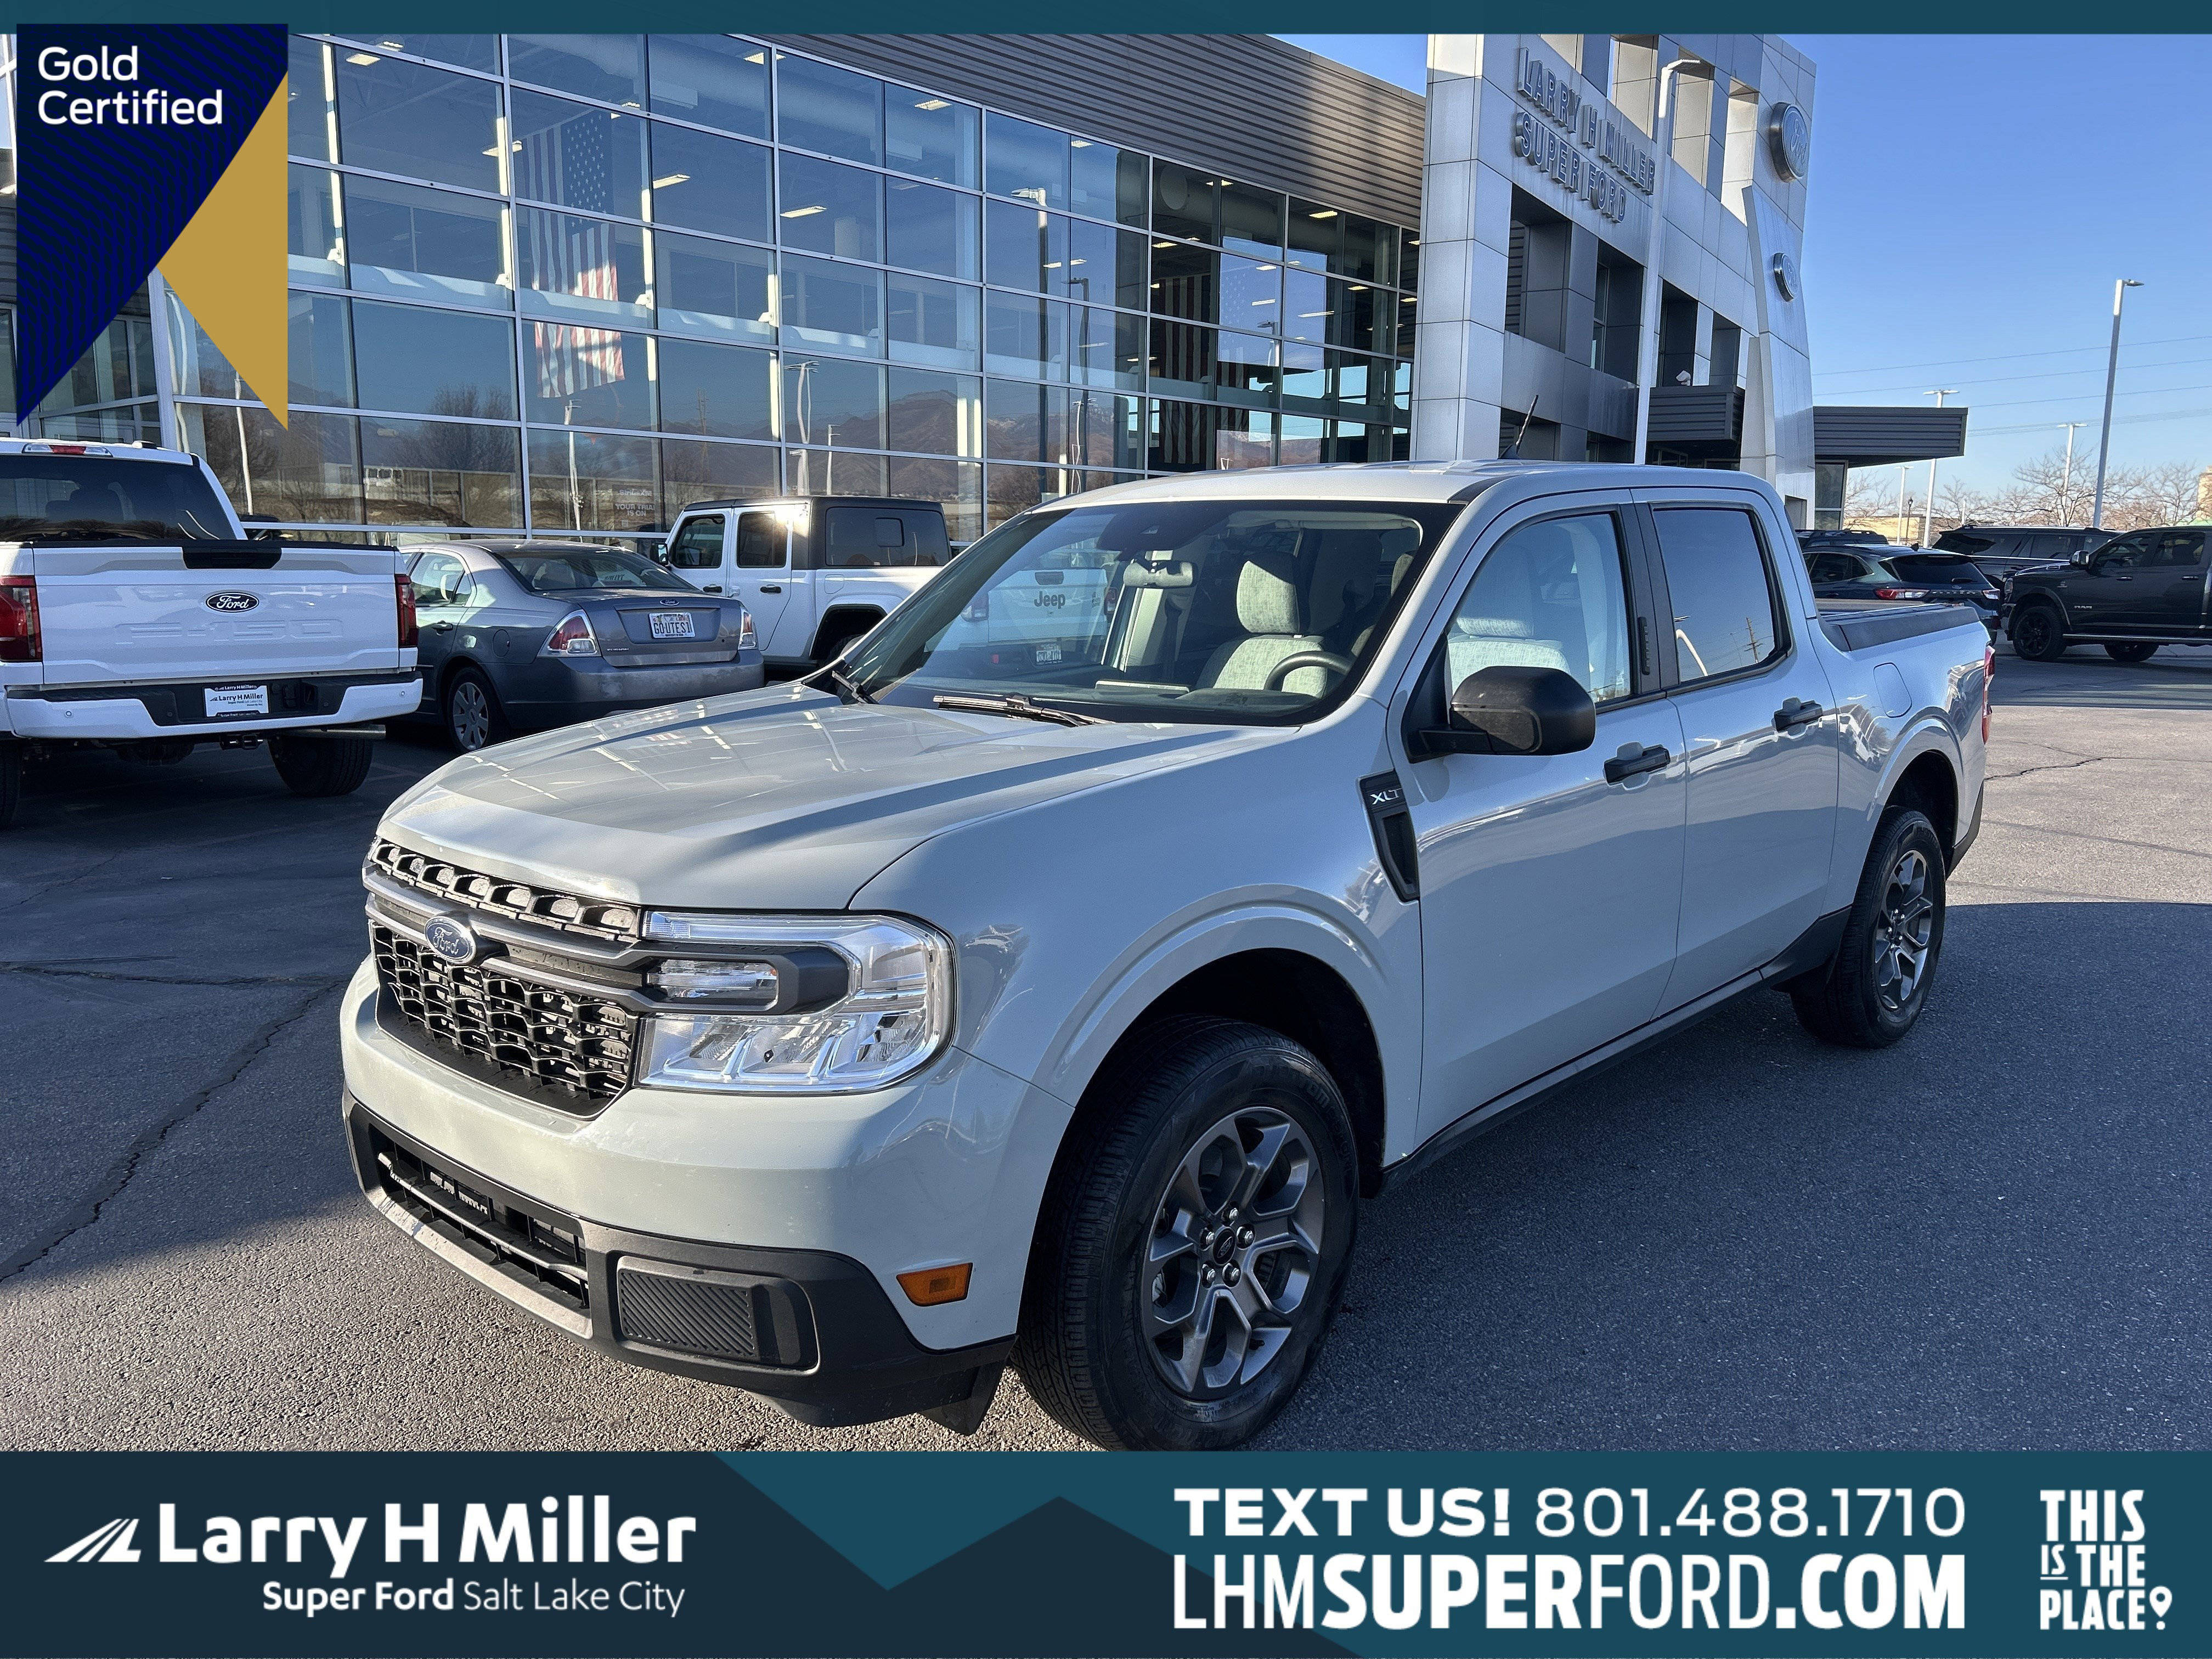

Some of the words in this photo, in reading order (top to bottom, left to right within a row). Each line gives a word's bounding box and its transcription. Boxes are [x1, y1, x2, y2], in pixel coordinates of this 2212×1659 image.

[1517, 47, 1582, 133] LARRY
[1582, 104, 1598, 149] H
[1599, 119, 1656, 195] MILLER
[1515, 111, 1581, 193] SUPER
[1581, 161, 1627, 223] FORD
[216, 595, 250, 609] Ford
[1034, 591, 1065, 609] Jeep
[1370, 788, 1403, 805] XLT
[433, 927, 460, 955] Ford
